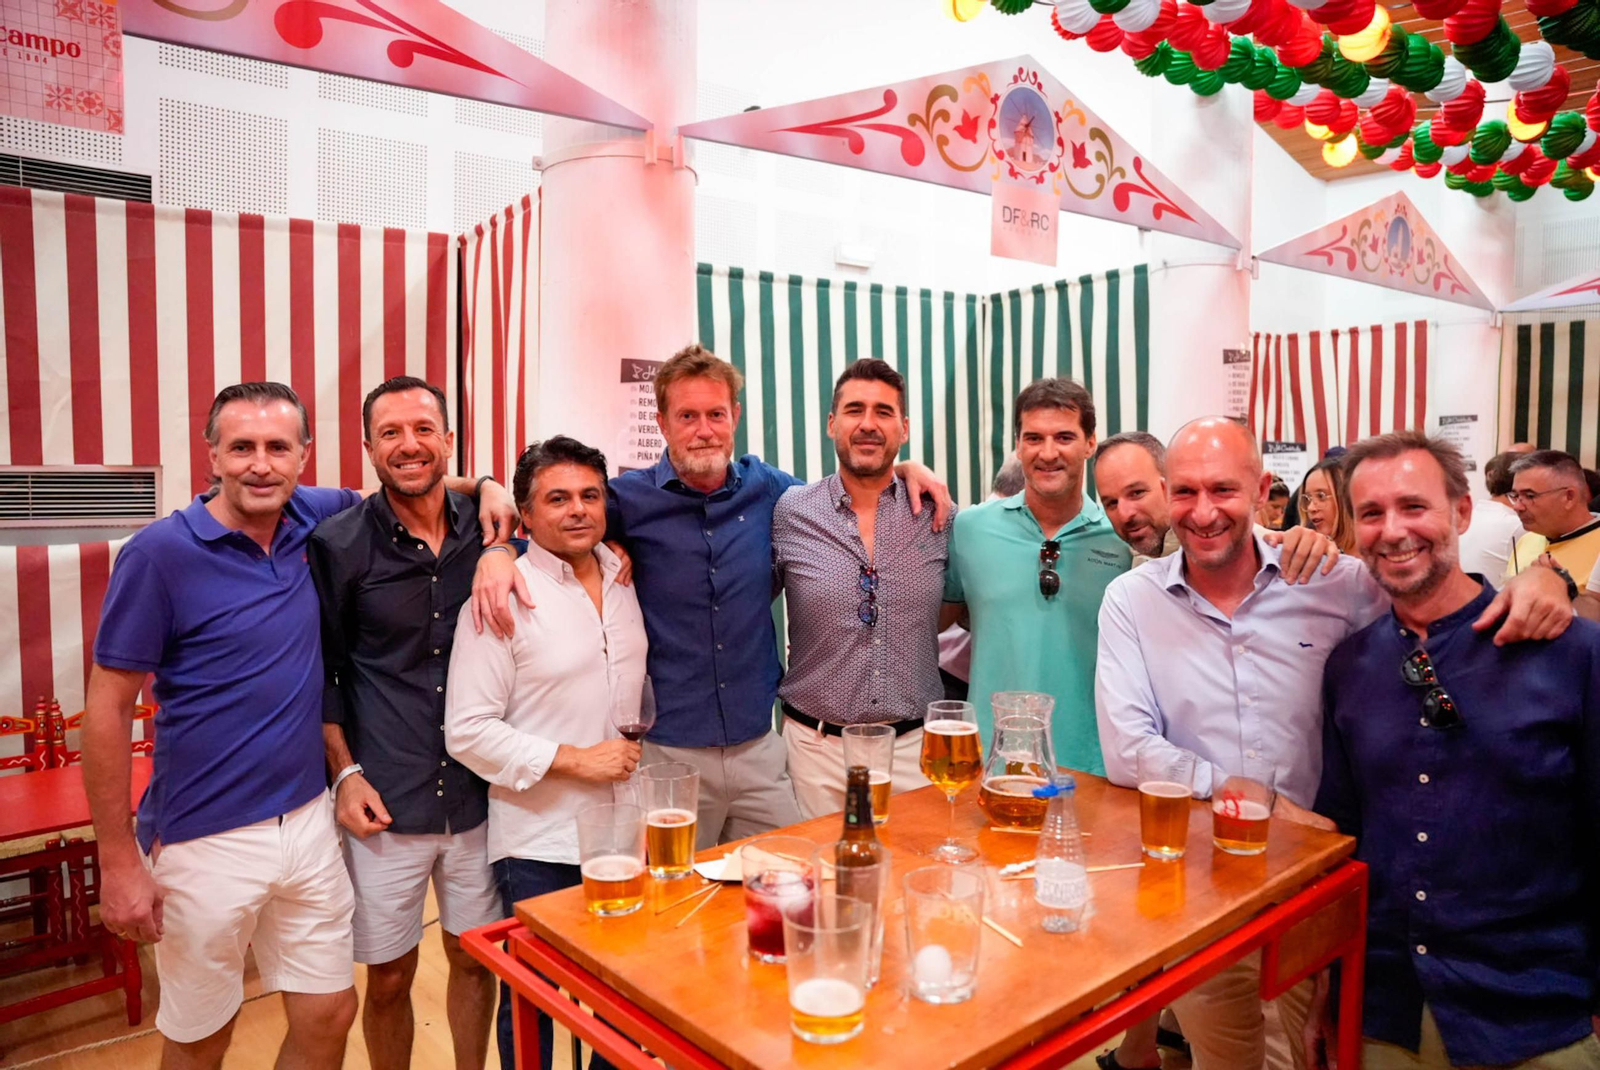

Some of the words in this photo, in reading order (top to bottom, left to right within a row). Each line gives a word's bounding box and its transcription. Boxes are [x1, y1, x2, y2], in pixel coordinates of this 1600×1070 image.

[1002, 205, 1050, 231] DF&RC
[638, 411, 647, 420] DE
[638, 425, 659, 435] VERDE
[637, 438, 662, 448] ALBERO
